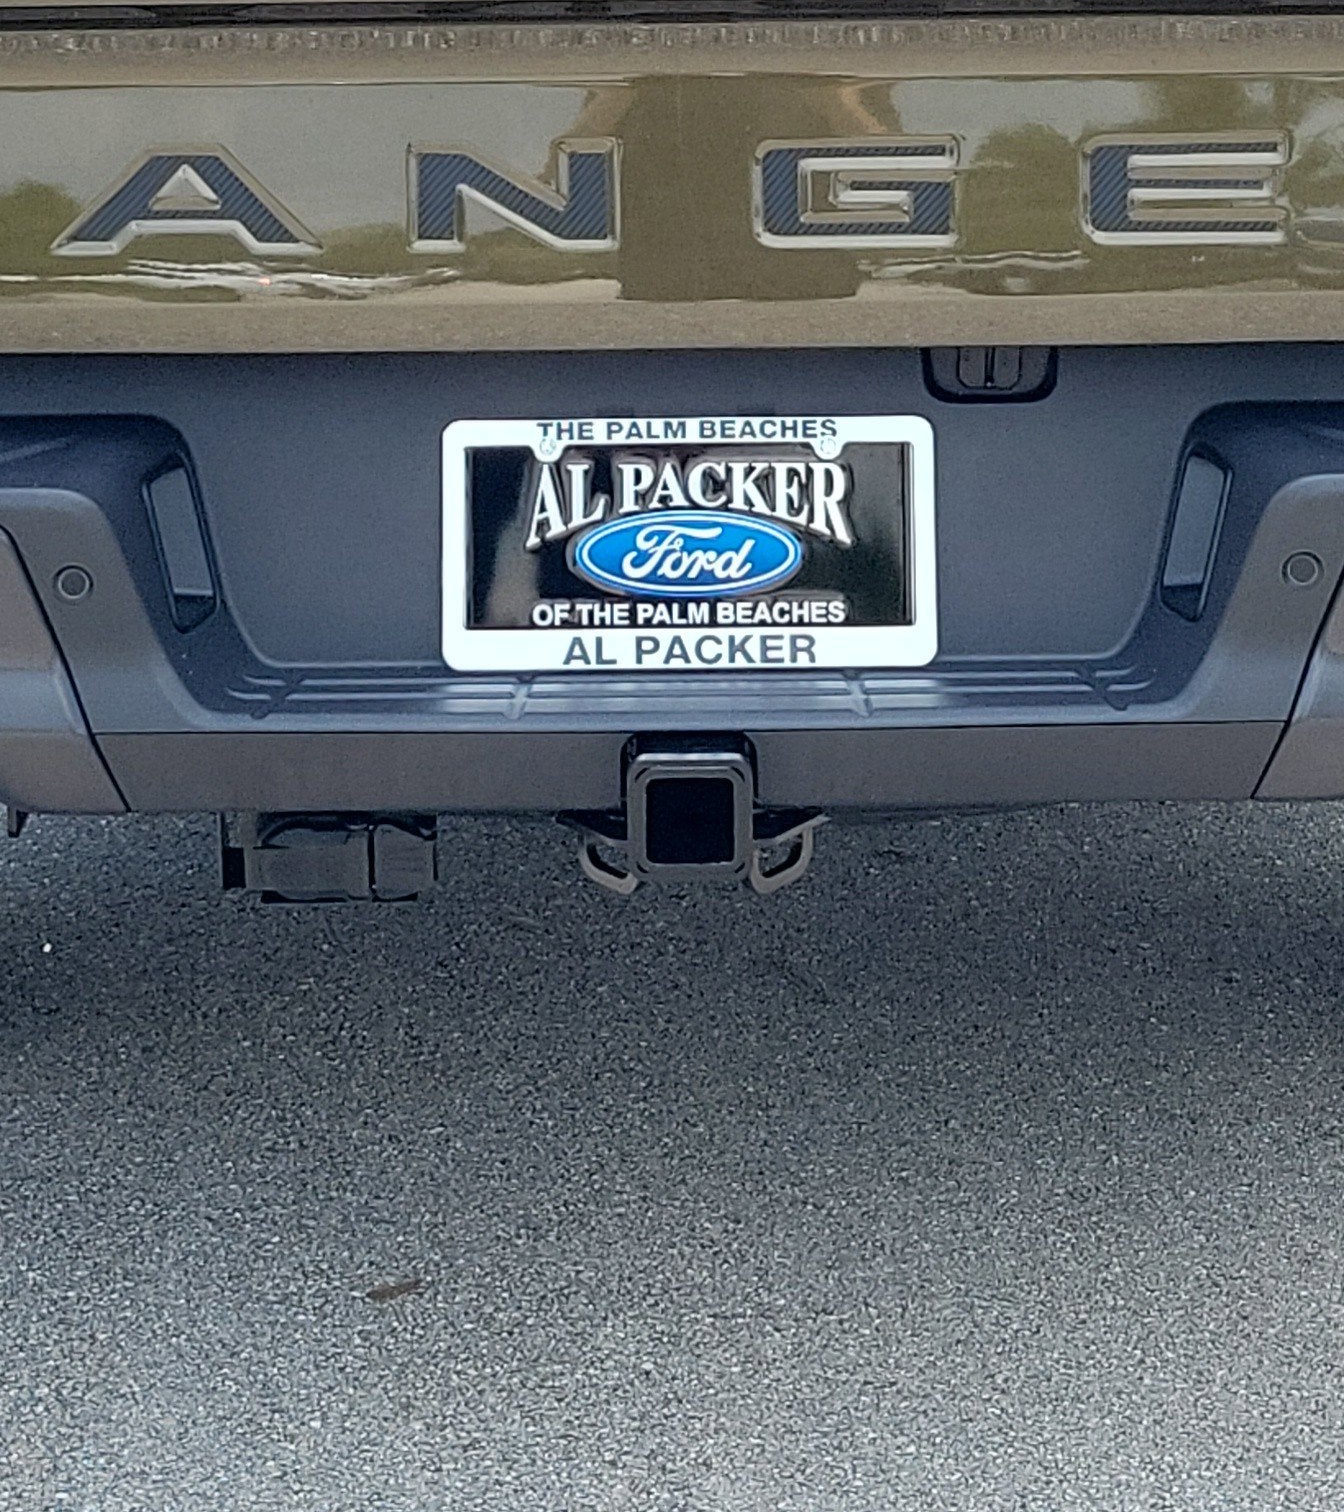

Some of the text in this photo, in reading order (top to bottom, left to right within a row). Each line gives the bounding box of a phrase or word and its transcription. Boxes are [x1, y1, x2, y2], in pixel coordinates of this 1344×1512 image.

[536, 418, 838, 442] THE PALM BEACHES
[524, 459, 853, 552] AL PACKER
[622, 524, 755, 580] Ford
[532, 600, 846, 627] OF THE PALM BEACHES
[563, 633, 817, 666] AL PACKER
